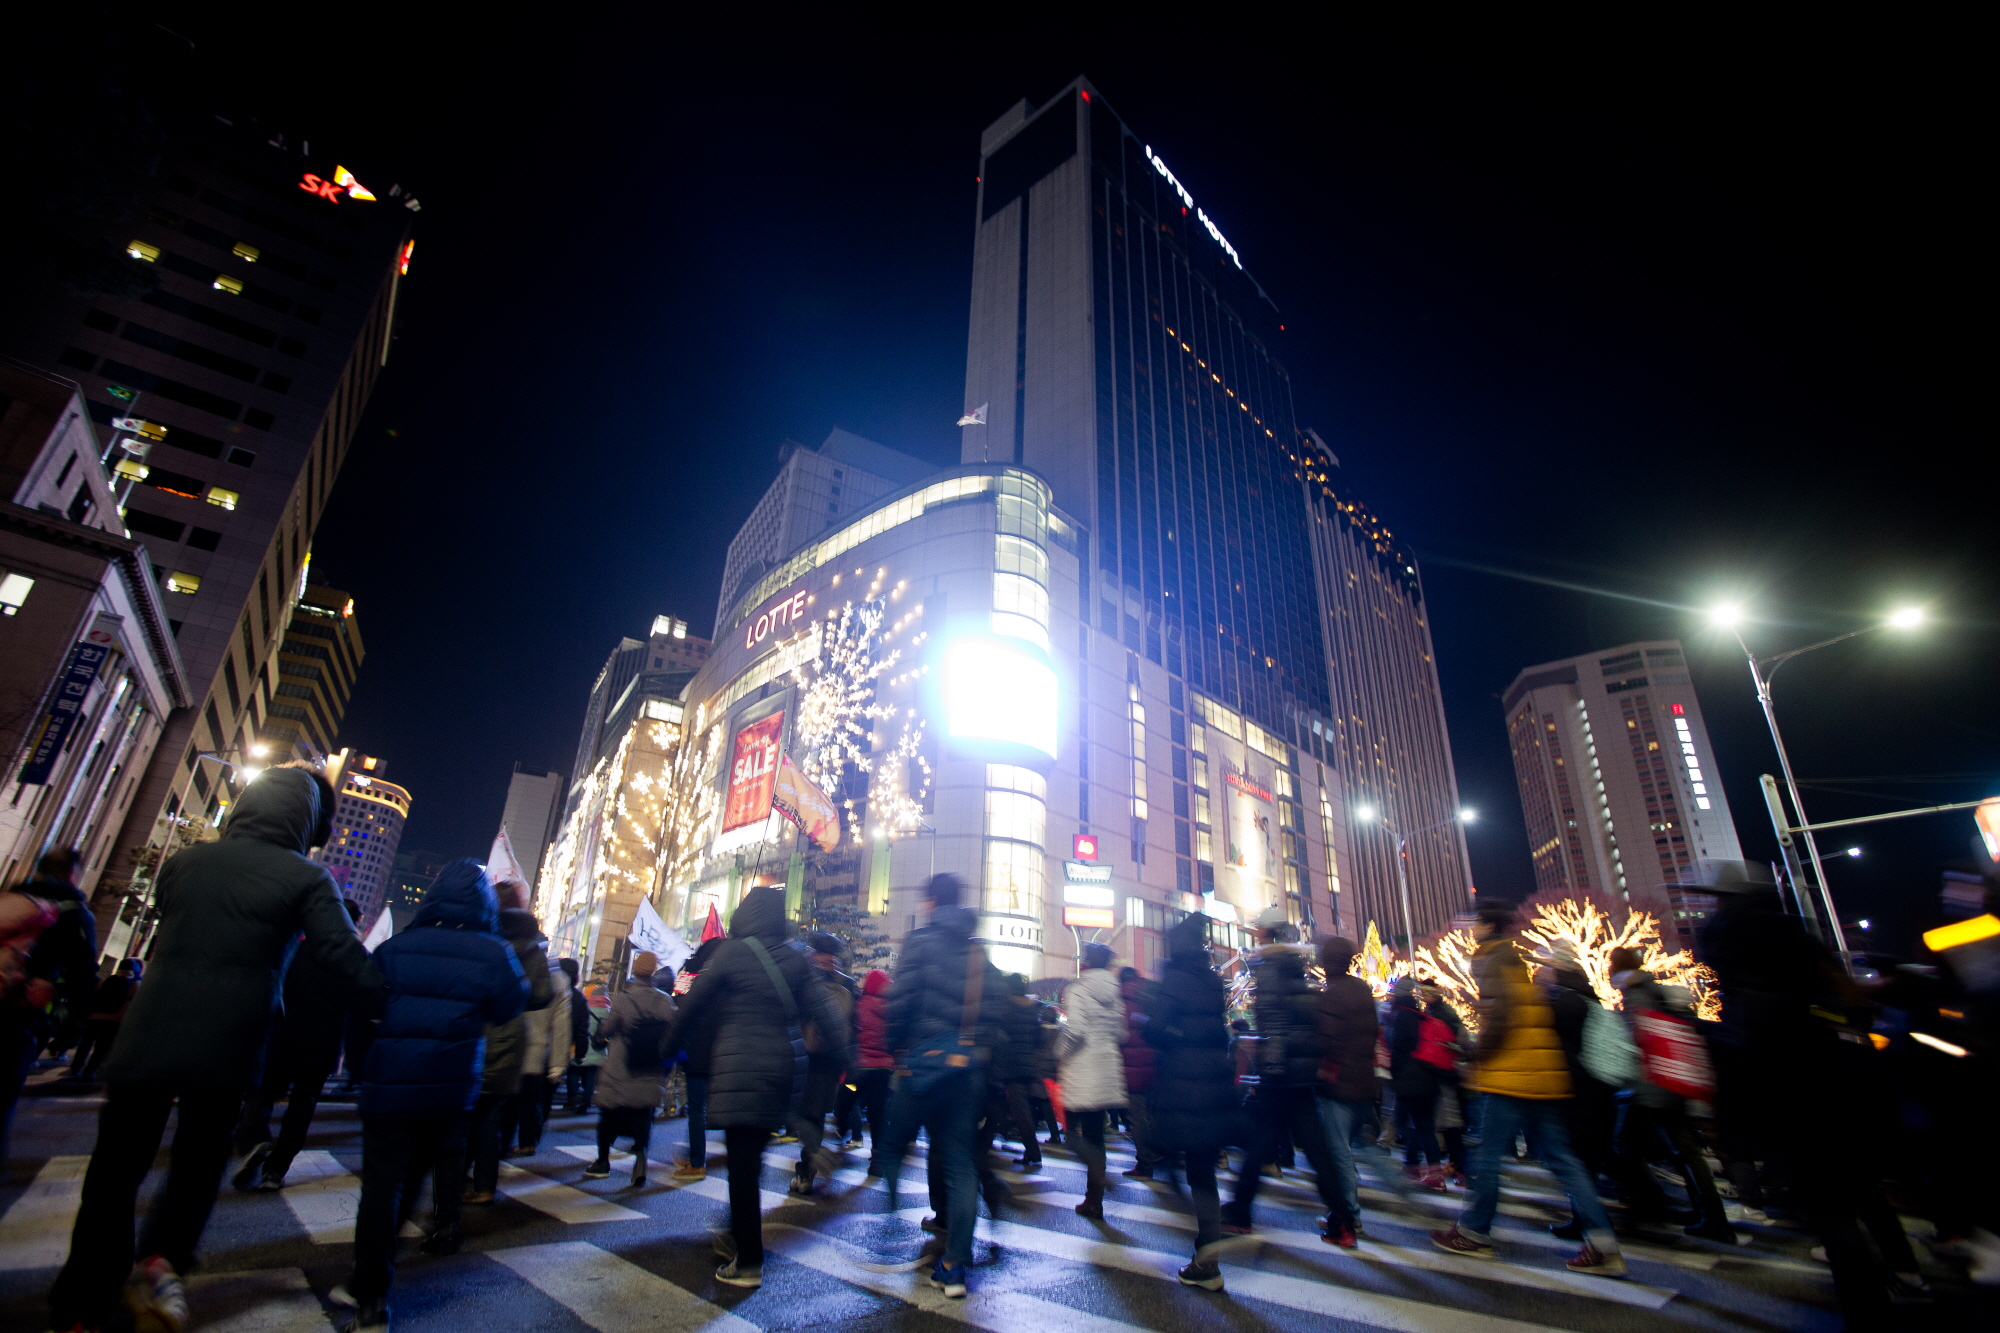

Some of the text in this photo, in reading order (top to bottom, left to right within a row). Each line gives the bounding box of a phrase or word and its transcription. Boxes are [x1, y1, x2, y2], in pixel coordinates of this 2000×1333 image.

[298, 173, 344, 204] SK
[1145, 144, 1194, 209] LOTTE
[746, 589, 807, 650] LOTTE
[732, 743, 777, 786] SALE
